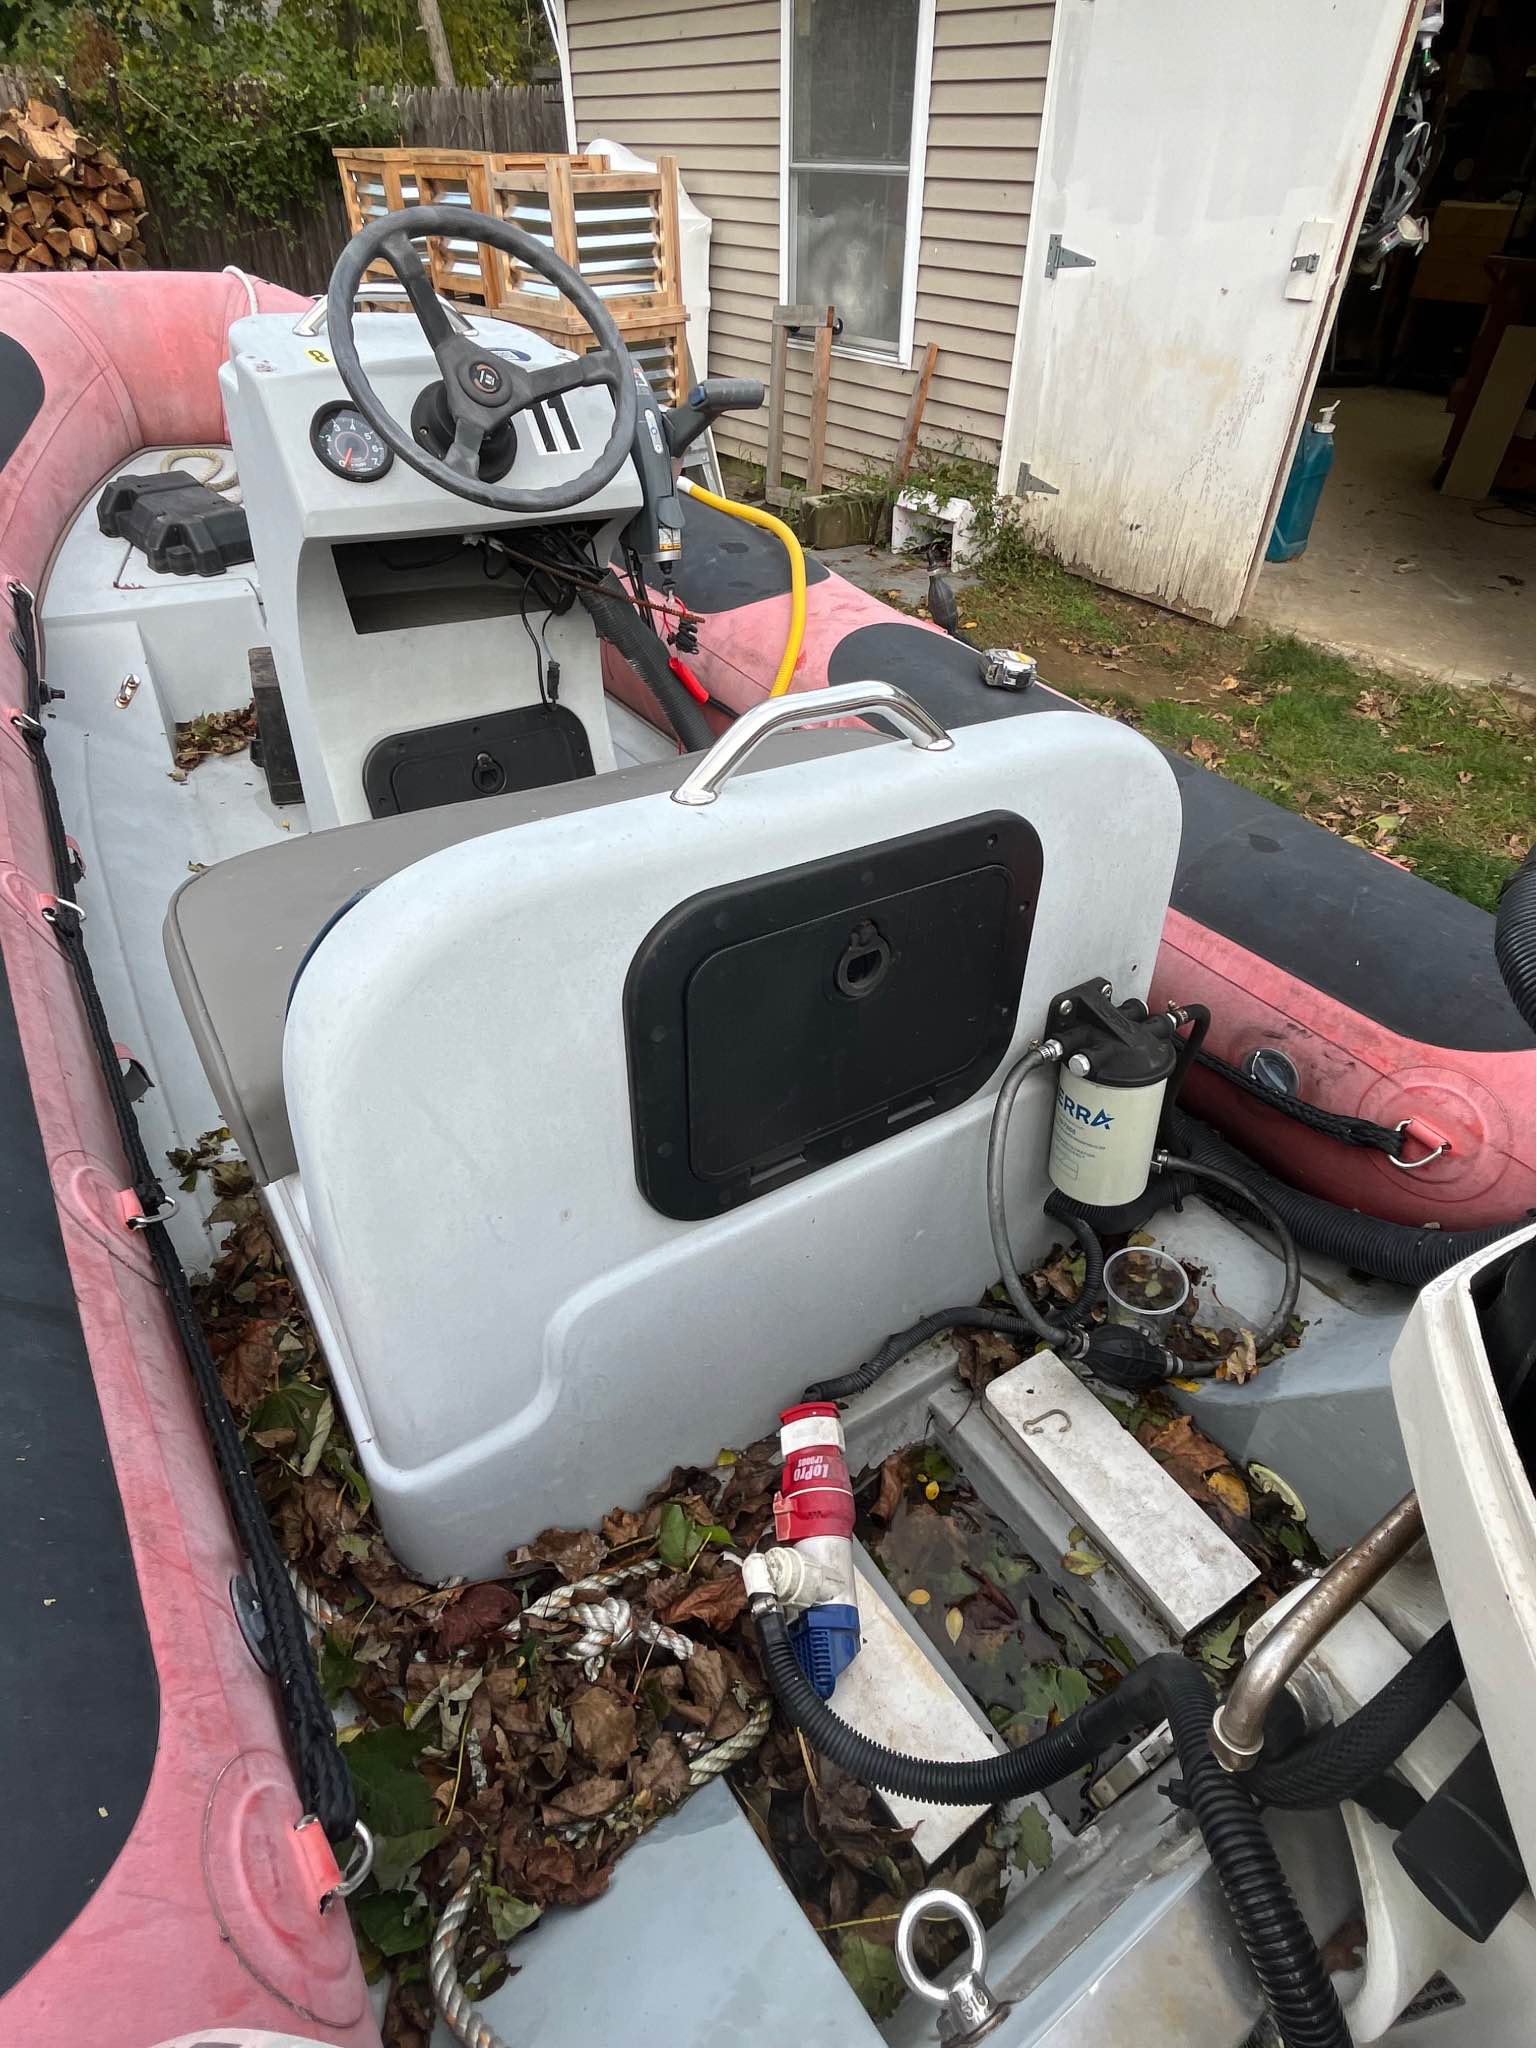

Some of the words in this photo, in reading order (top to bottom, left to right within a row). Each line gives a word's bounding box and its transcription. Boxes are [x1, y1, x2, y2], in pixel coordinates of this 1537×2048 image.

[326, 434, 332, 442] 2
[364, 432, 372, 440] 5
[372, 444, 379, 452] 6
